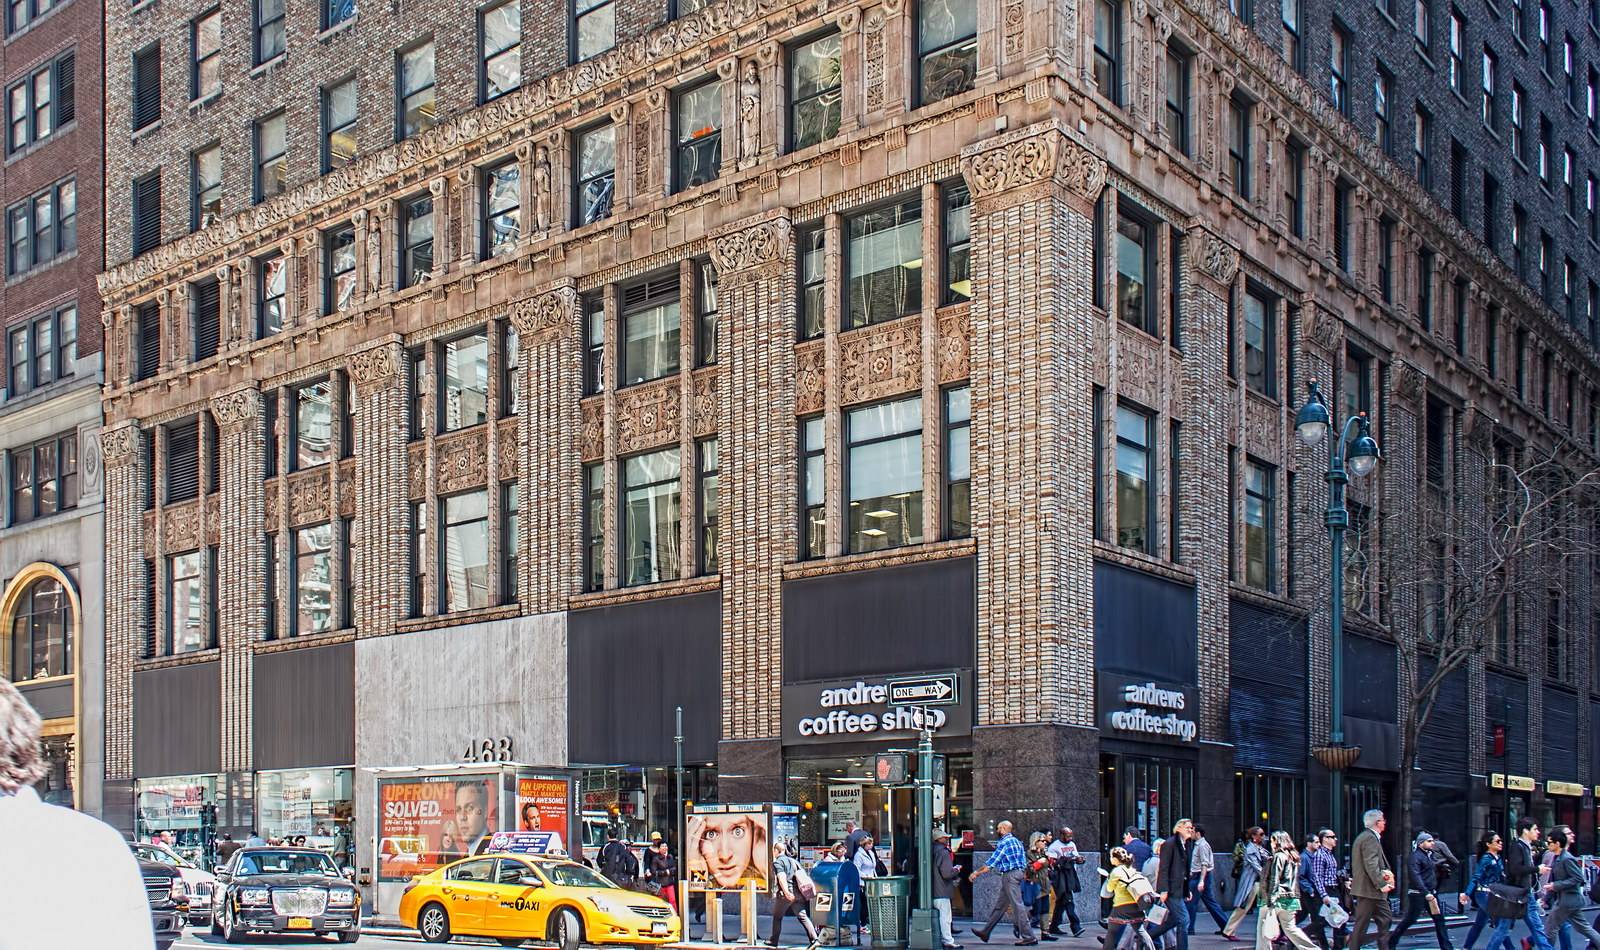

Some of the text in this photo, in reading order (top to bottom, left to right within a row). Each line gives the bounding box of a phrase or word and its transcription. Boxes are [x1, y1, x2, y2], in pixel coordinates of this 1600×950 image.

[820, 681, 888, 708] andre
[895, 685, 944, 697] ONE WAY
[1125, 682, 1185, 710] andrews
[798, 707, 946, 736] coffee shp
[1111, 707, 1197, 742] coffee shop
[463, 736, 513, 763] 463
[384, 783, 453, 801] UPFRONT
[520, 782, 567, 792] AN UPFRONT
[830, 789, 860, 798] BREAKFAST
[384, 800, 442, 818] SOLVED.
[690, 870, 706, 882] FX
[515, 897, 540, 911] TAXI
